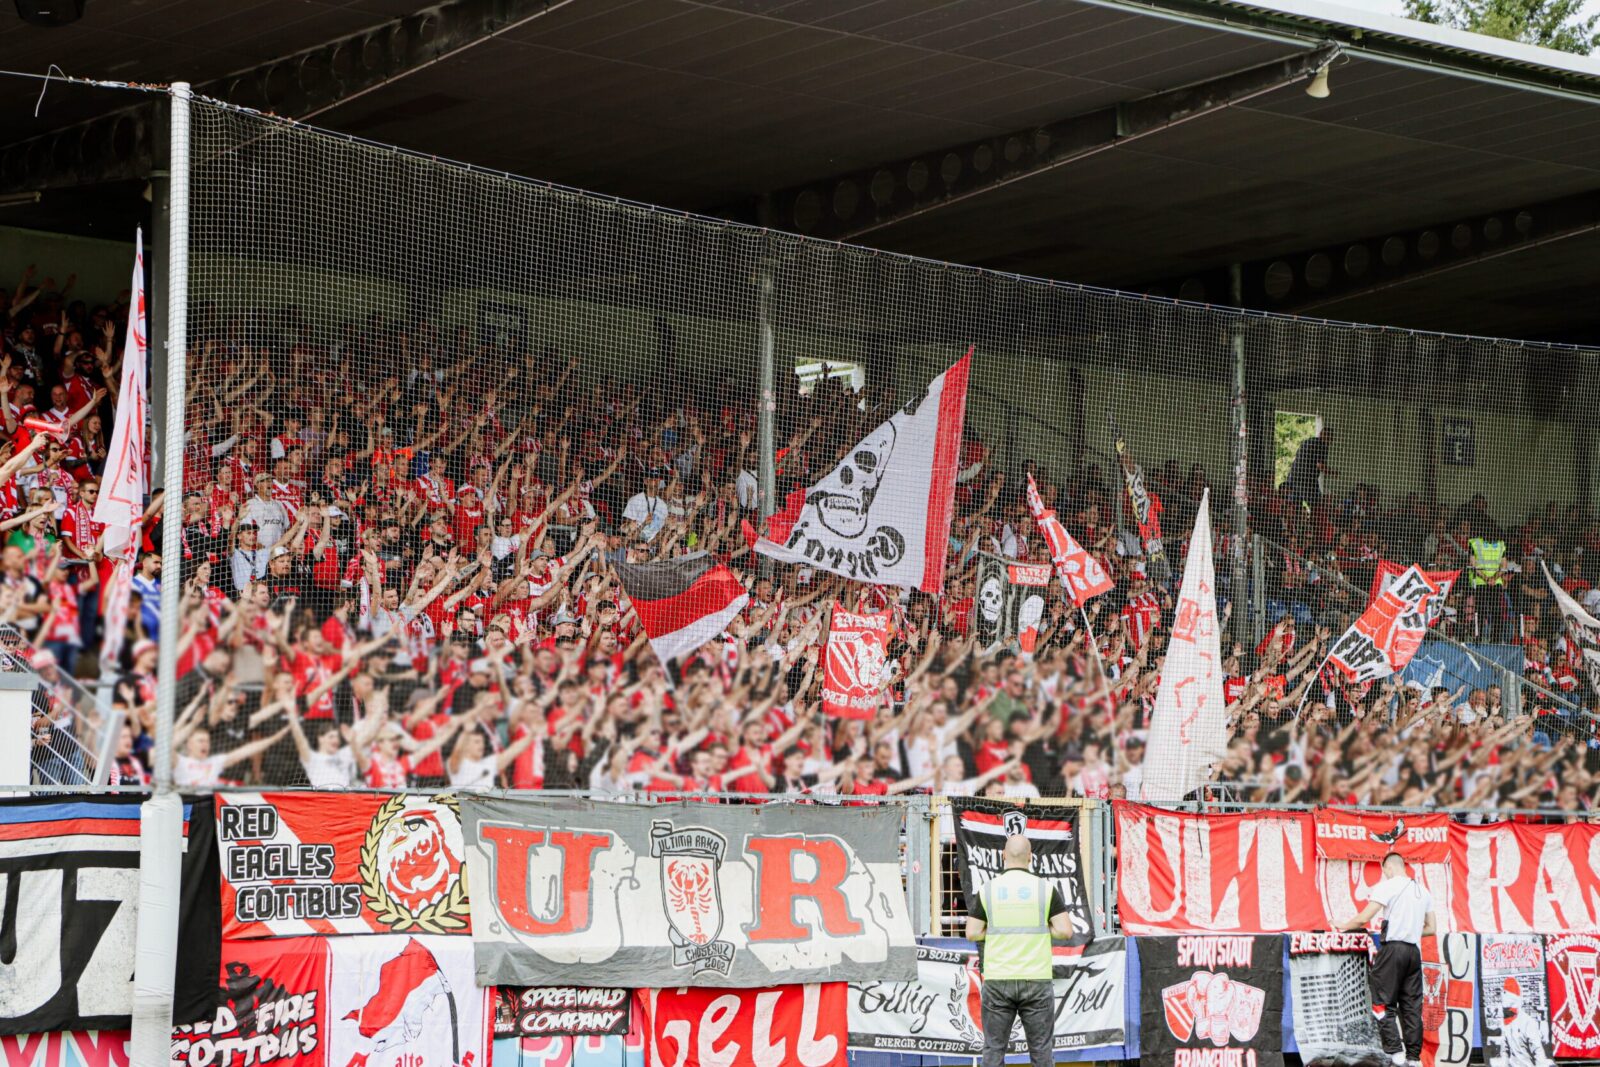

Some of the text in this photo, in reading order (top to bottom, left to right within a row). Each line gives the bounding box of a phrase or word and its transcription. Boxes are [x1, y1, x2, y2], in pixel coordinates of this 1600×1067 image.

[221, 805, 278, 841] RED
[1317, 823, 1448, 842] ELSTER FRONT
[658, 835, 720, 854] ULTIMA RAKA
[228, 844, 335, 883] EAGLES
[236, 884, 362, 922] COTTBUS
[704, 957, 726, 972] 2002
[1177, 936, 1255, 972] SPORTSTADT
[521, 987, 626, 1008] SPREEWALD
[256, 989, 317, 1033] FIRE
[520, 1011, 625, 1032] COMPANY
[874, 1037, 966, 1052] ENERGIE COTTBUS
[1055, 1034, 1086, 1047] EHREN
